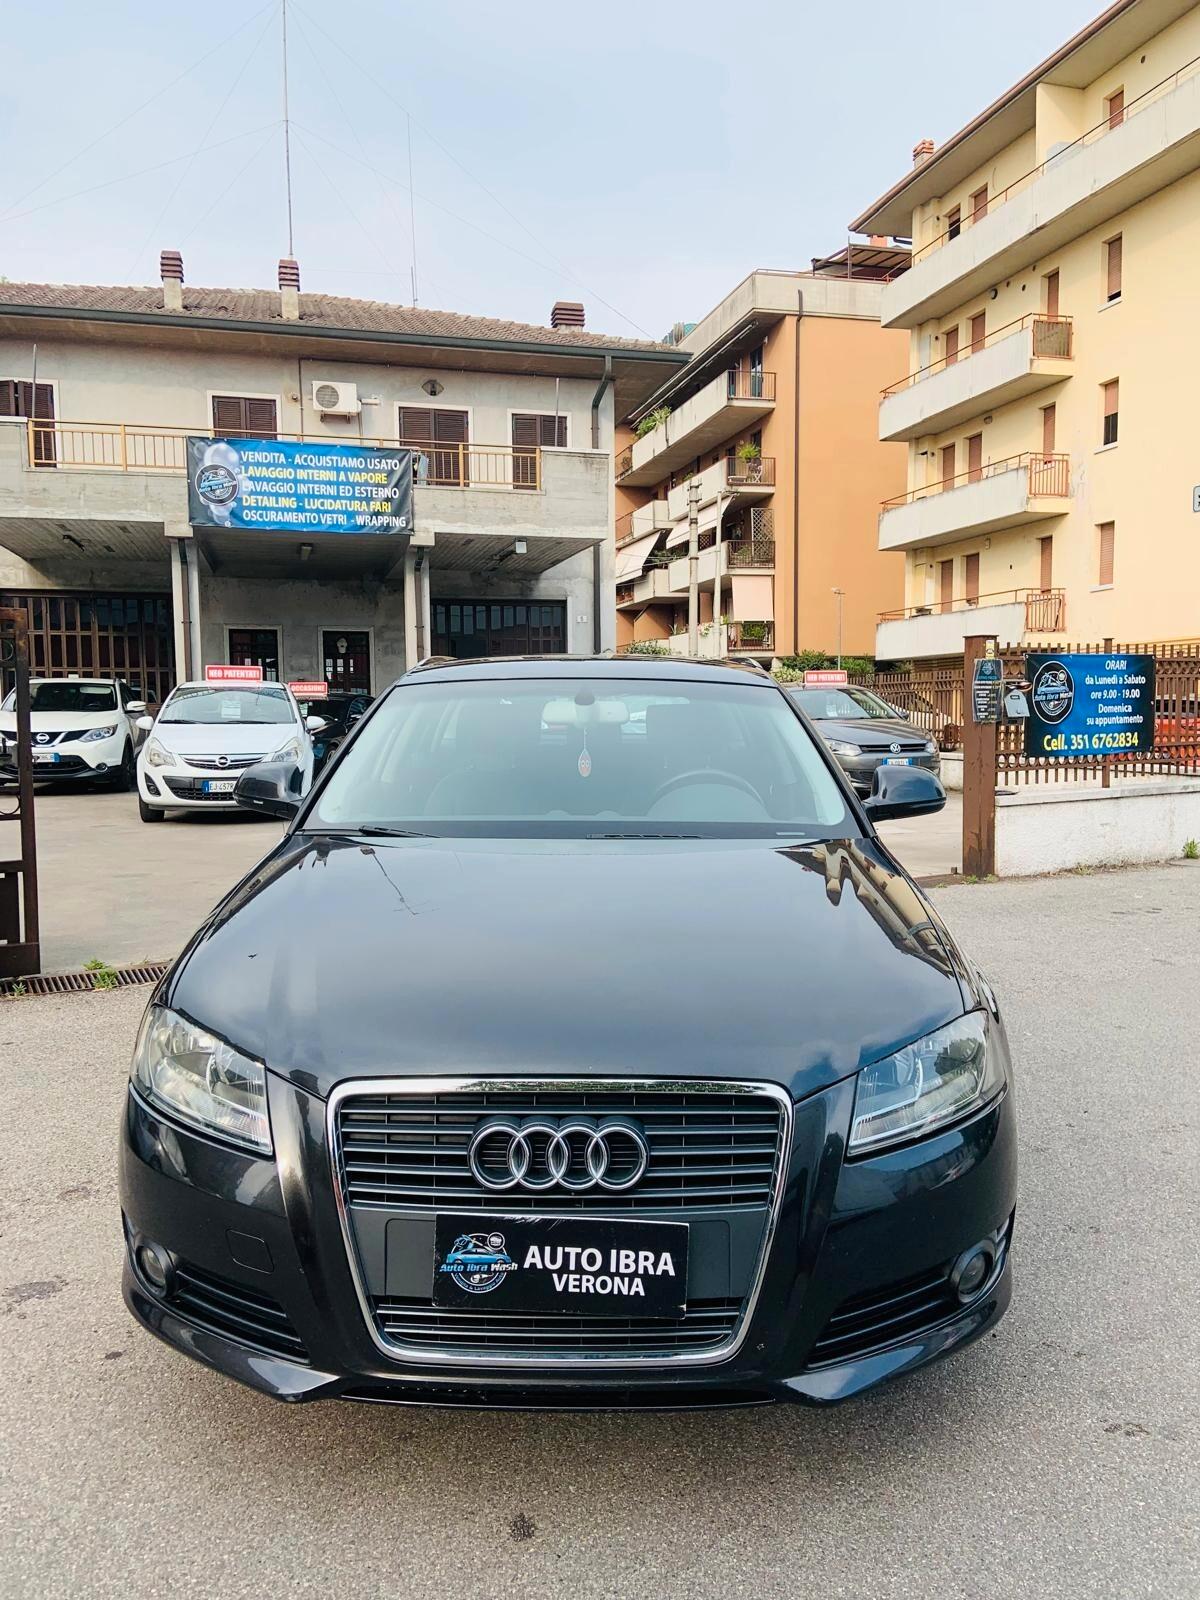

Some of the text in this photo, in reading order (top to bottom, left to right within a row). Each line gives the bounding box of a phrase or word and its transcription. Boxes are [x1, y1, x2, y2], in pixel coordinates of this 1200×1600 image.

[240, 451, 286, 464] VENDITA
[294, 454, 365, 469] ACQUISTIAMO
[367, 458, 400, 471] USATO
[241, 465, 388, 484] LAVAGGIO INTERNI A VAPORE
[242, 481, 399, 499] LAVAGGIO INTERNI ED ESTERNO
[242, 495, 297, 508] DETAILING
[304, 498, 368, 512] LUCIDATURA
[370, 501, 391, 513] FARI
[243, 510, 318, 524] OSCURAMENTO
[319, 513, 347, 525] VETRI
[356, 515, 406, 527] WRAPPING
[1105, 660, 1127, 670] ORARI
[291, 684, 325, 692] OCCASIONE
[1085, 675, 1094, 685] da
[1124, 674, 1146, 685] Sabato
[1090, 691, 1102, 699] ore
[1102, 689, 1117, 699] 9.00
[1122, 689, 1140, 698] 19.00
[1098, 703, 1132, 714] Domenica
[1086, 714, 1143, 727] su appuntamento
[1043, 732, 1139, 751] Cell. 351 6762834
[439, 1262, 518, 1272] Auto Ibra Wash
[523, 1245, 676, 1277] AUTO IBRA
[552, 1273, 646, 1297] VERONA
